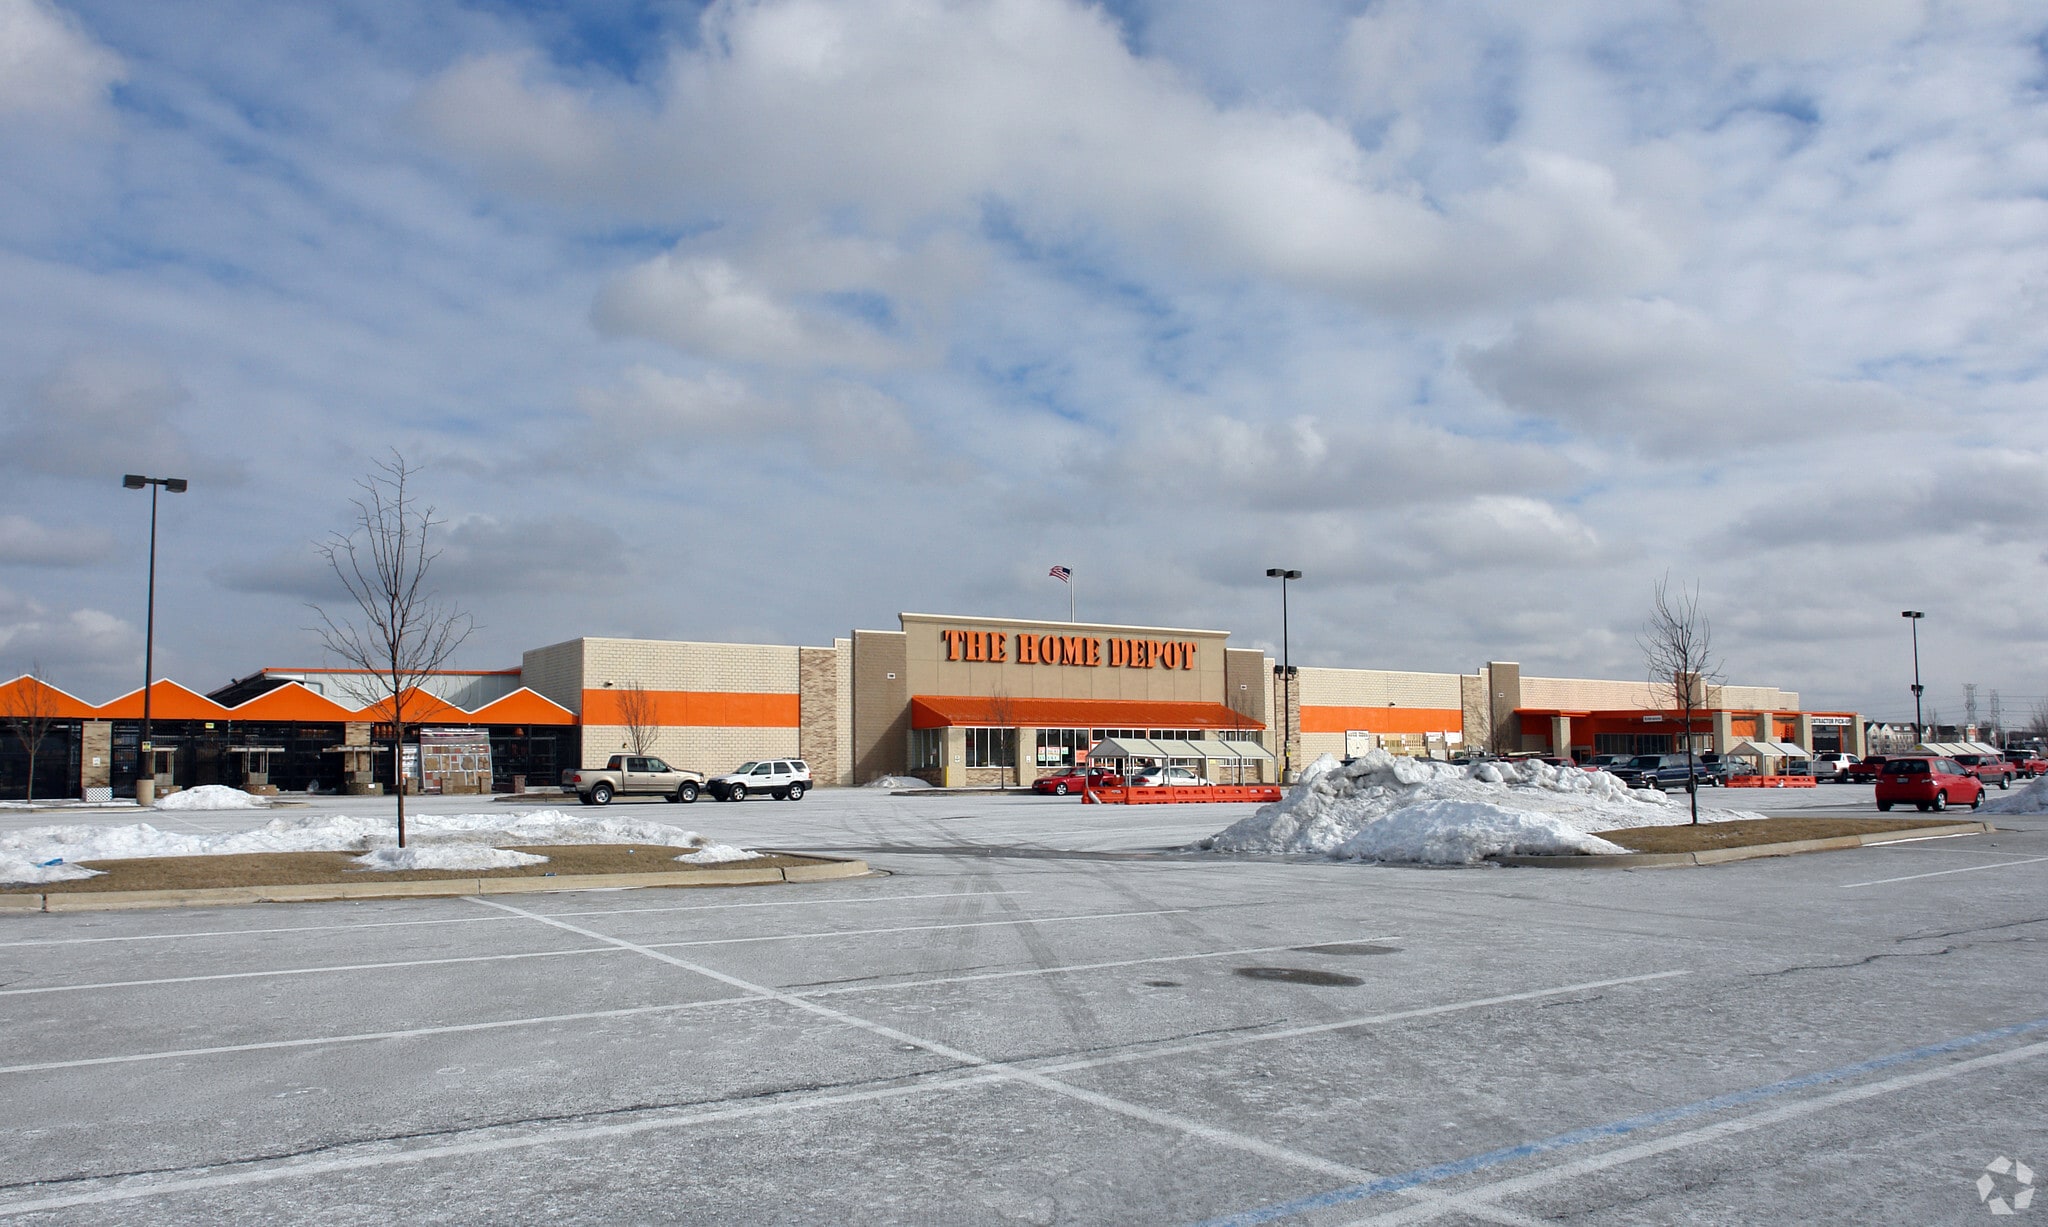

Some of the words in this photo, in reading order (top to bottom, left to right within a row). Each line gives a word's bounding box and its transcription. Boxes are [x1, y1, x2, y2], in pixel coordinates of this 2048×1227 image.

[944, 629, 1008, 662] THE
[1017, 633, 1102, 666] HOME
[1108, 637, 1197, 670] DEPOT
